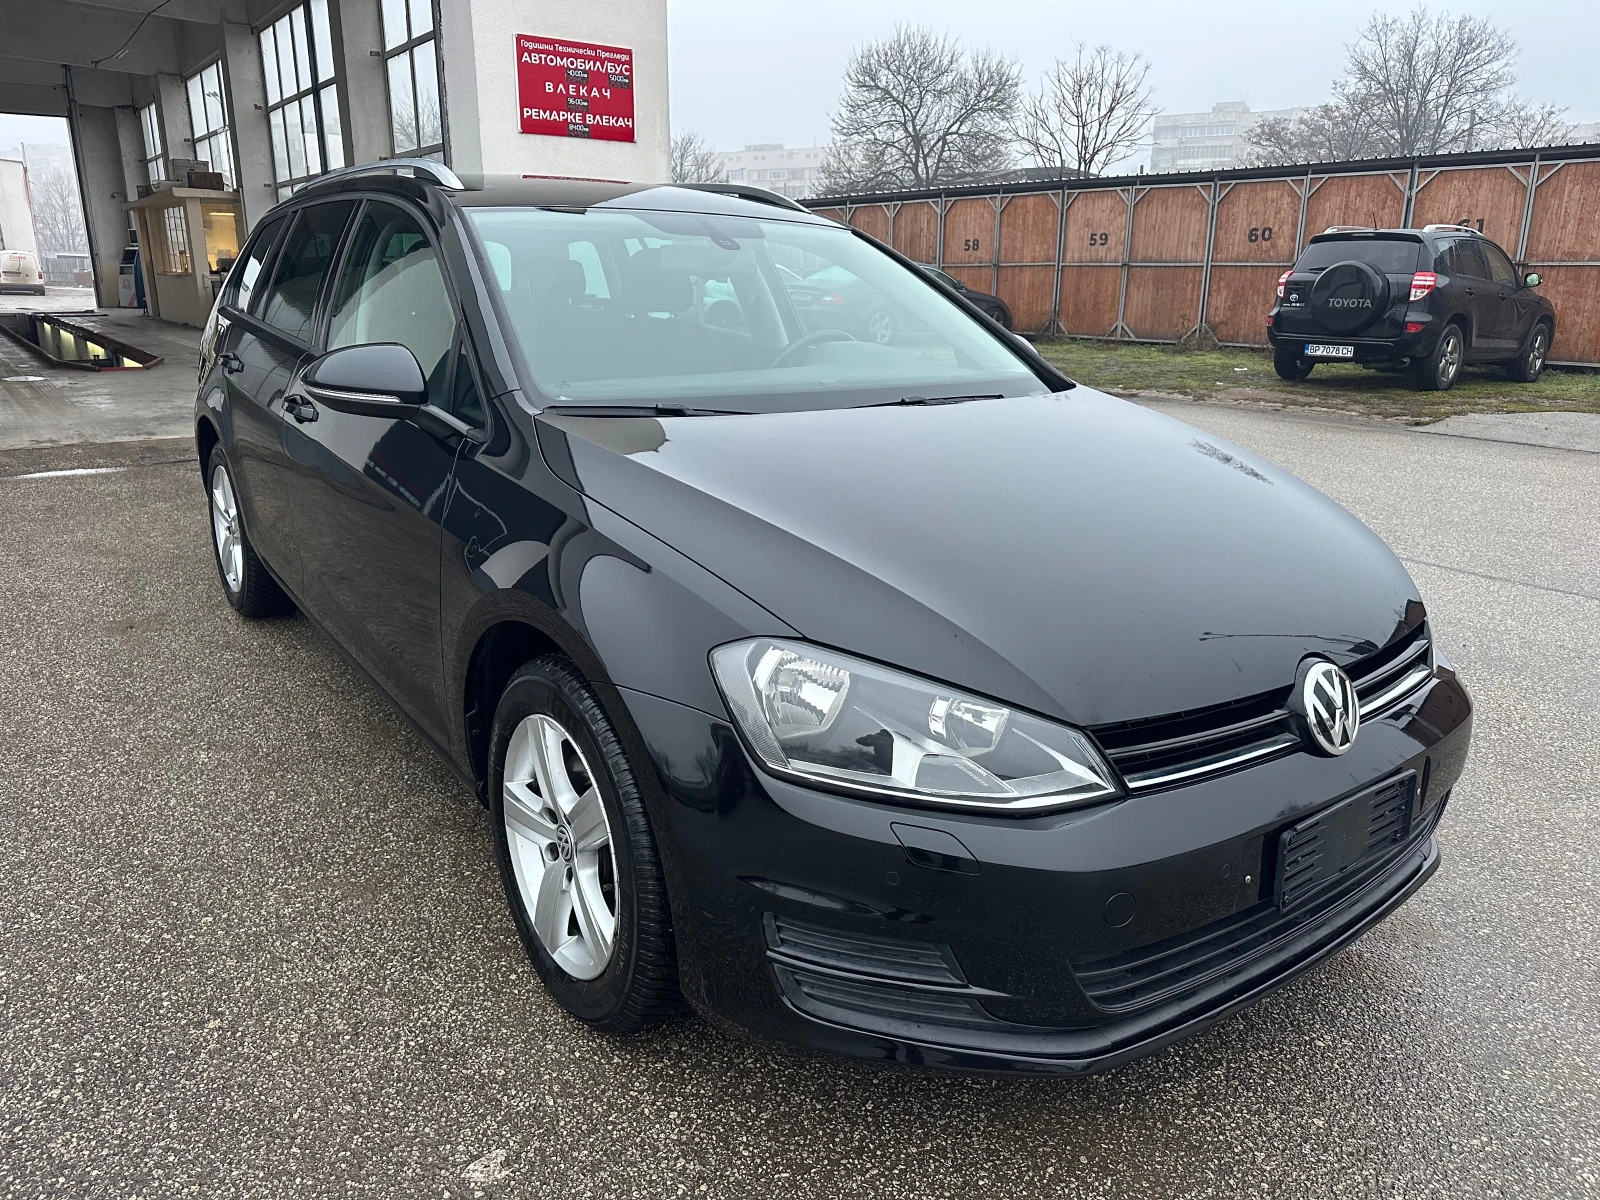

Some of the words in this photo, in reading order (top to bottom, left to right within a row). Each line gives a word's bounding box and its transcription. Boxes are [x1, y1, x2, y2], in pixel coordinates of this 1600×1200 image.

[520, 39, 553, 50] Годишни
[554, 43, 596, 56] Технически
[596, 49, 630, 61] Прегледи
[521, 51, 631, 75] АВТОМОБИЛ/БУС
[545, 81, 611, 99] ВЛЕКАЧ
[523, 107, 583, 124] РЕМАРКЕ
[586, 113, 633, 129] ВЛЕКАЧ
[1089, 232, 1109, 247] 59
[1247, 226, 1273, 243] 60
[964, 238, 980, 251] 58
[1329, 298, 1372, 308] TOYOTA
[1309, 345, 1320, 354] BP
[1321, 345, 1341, 355] 7078
[1341, 347, 1353, 356] CH
